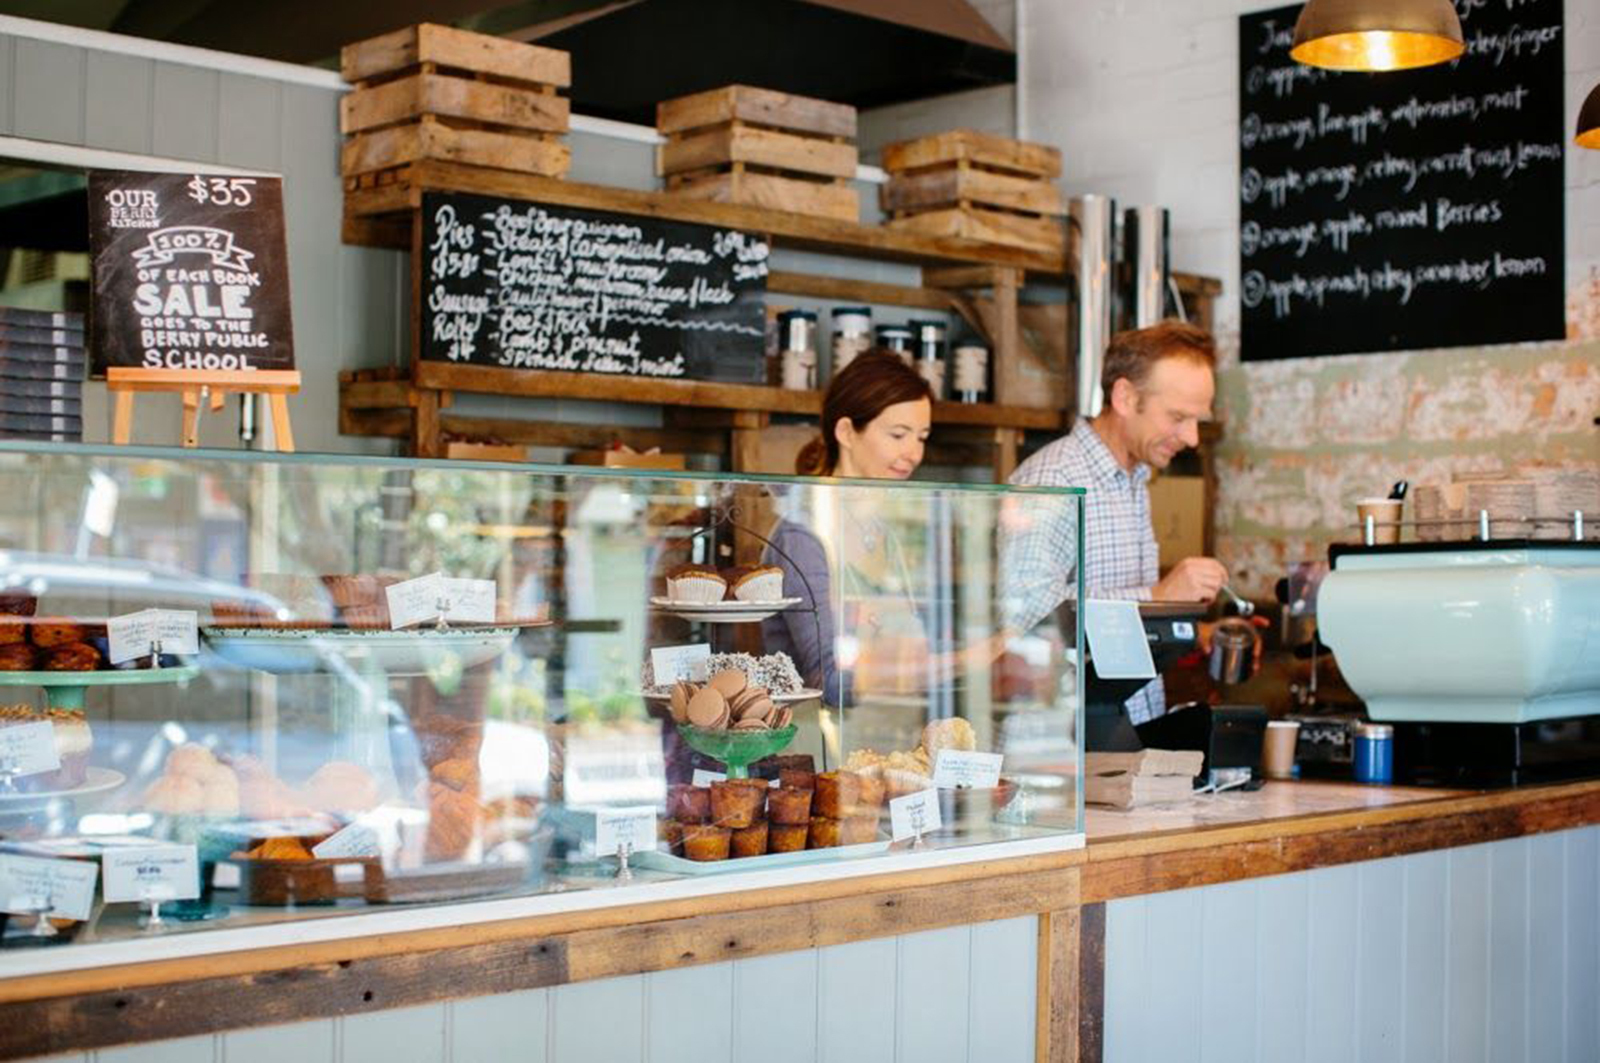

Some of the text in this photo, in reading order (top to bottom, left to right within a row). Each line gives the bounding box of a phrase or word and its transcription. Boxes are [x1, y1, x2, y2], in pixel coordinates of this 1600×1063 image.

[105, 189, 160, 207] OUR
[188, 175, 257, 207] $35
[158, 232, 221, 250] 100%
[137, 269, 261, 286] OF EACH BOOK
[133, 283, 253, 318] SALE
[140, 317, 251, 332] GOES TO THE
[141, 330, 269, 348] BERRY PUBLIC
[142, 349, 257, 371] SCHOOL
